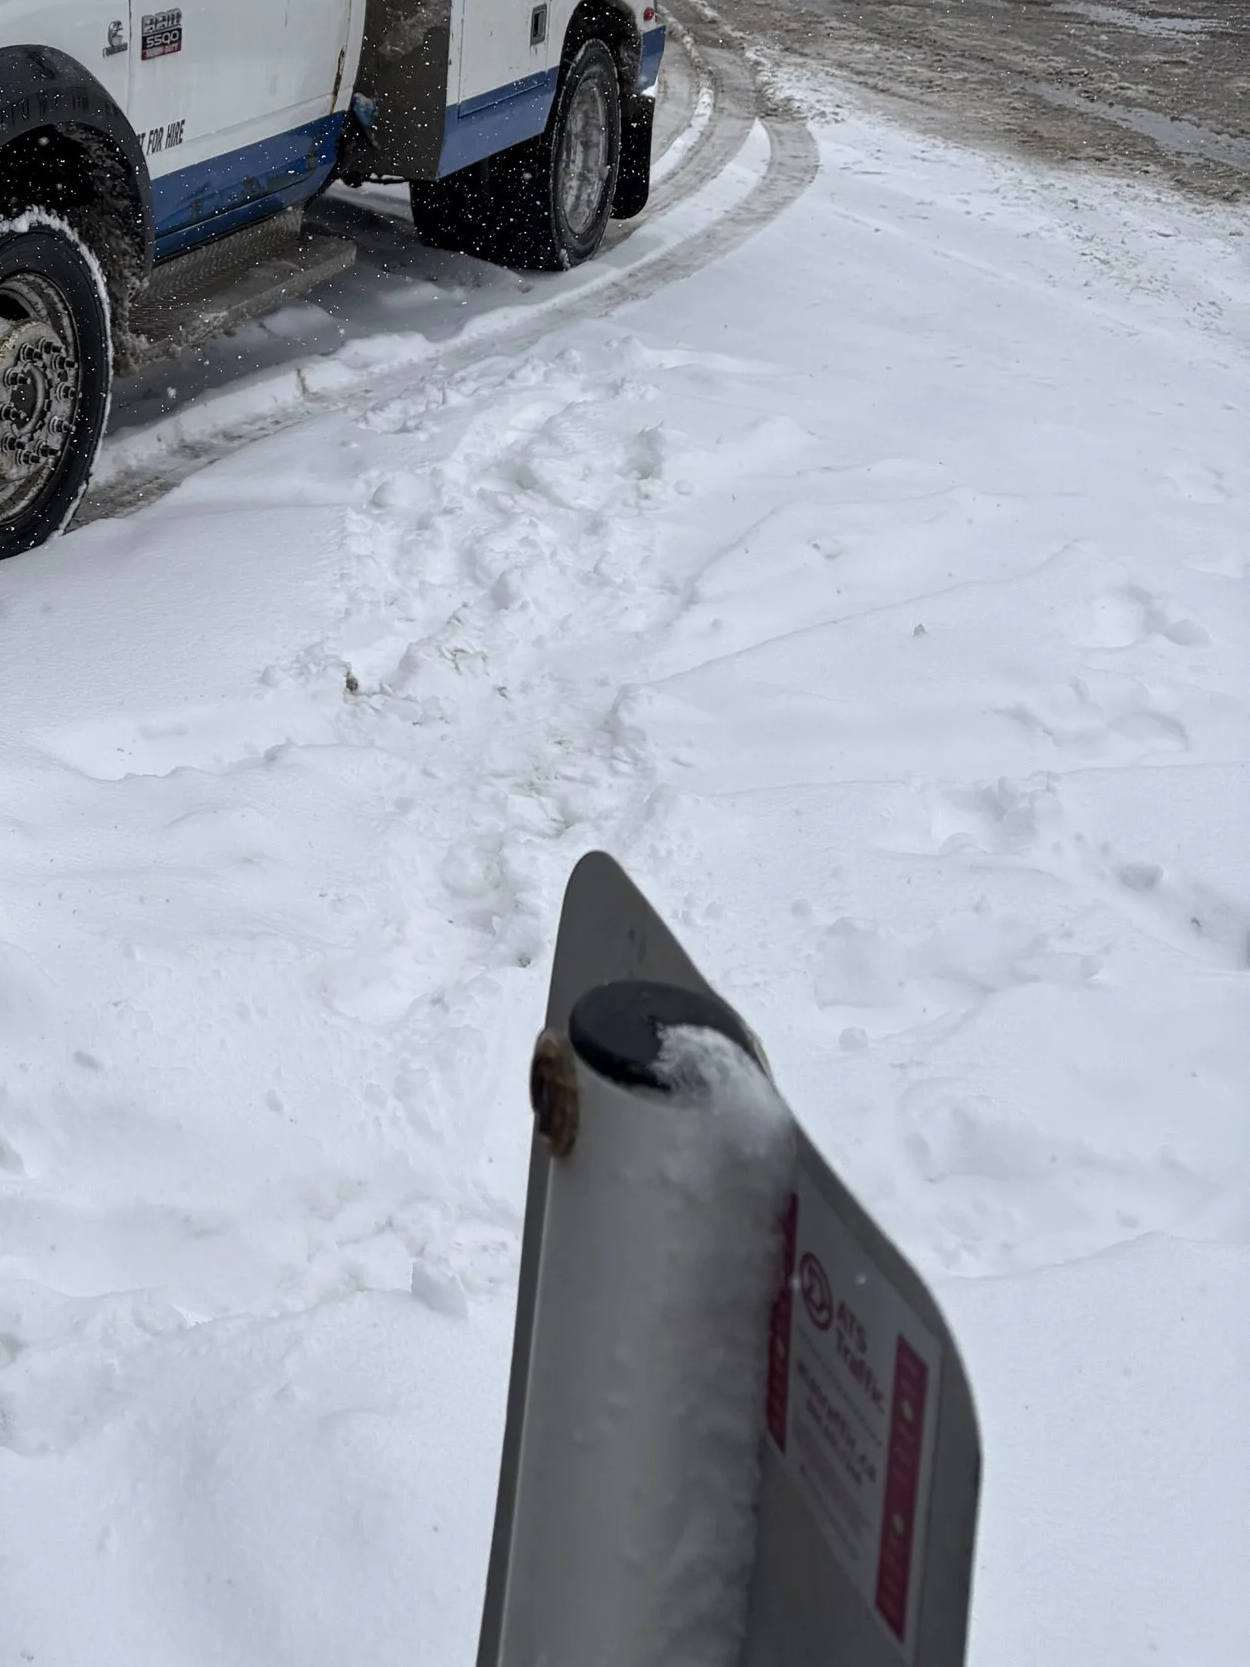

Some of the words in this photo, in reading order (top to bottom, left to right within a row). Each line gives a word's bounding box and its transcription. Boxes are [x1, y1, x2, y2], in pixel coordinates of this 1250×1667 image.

[146, 30, 179, 49] 5500
[147, 127, 164, 155] FOR
[165, 119, 185, 149] HIRE
[836, 1300, 867, 1354] ATS
